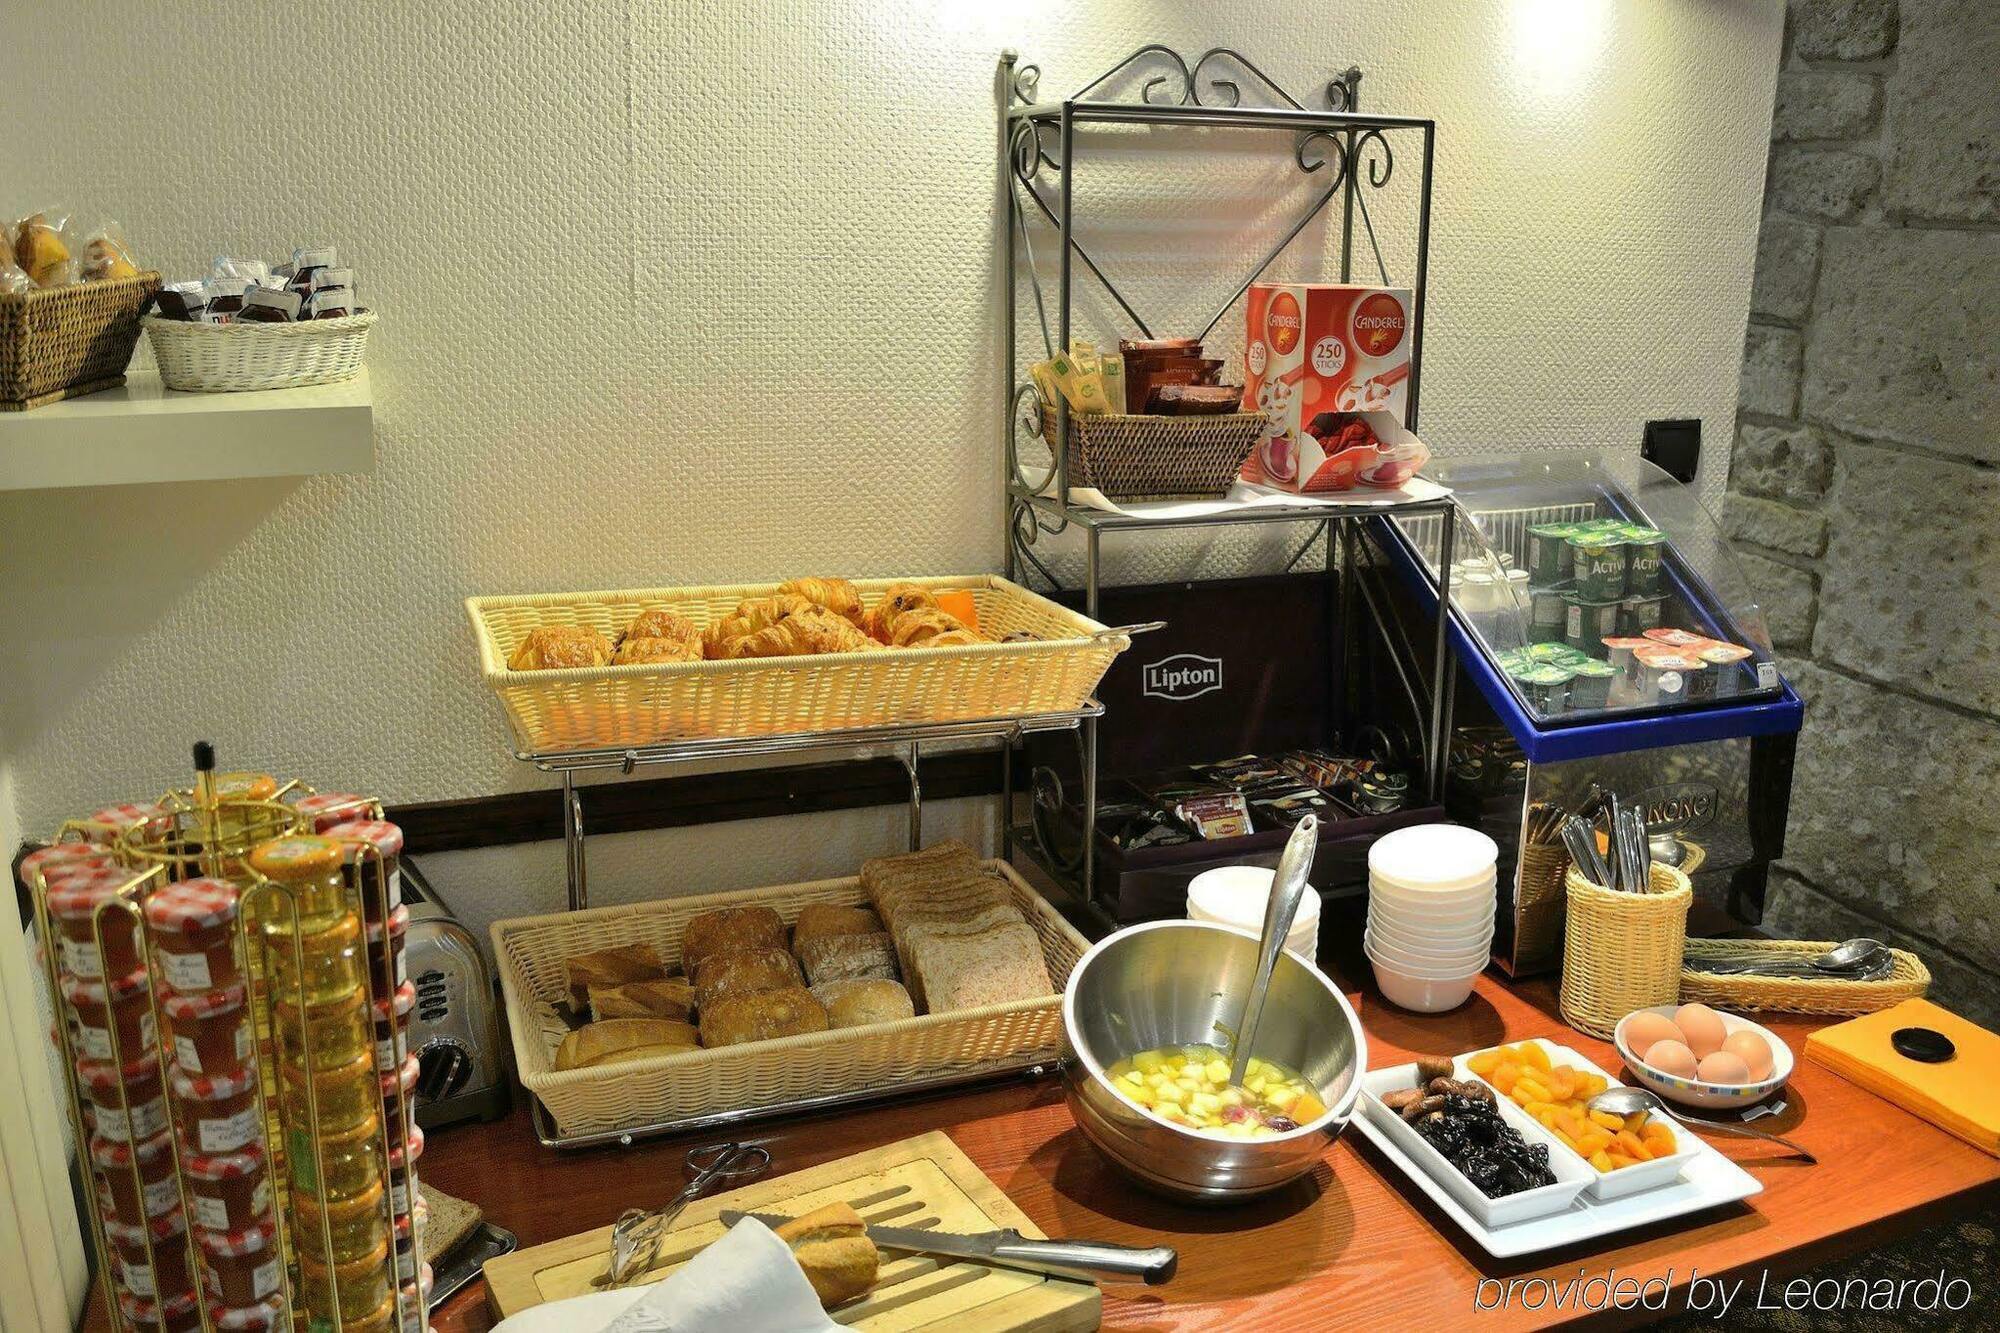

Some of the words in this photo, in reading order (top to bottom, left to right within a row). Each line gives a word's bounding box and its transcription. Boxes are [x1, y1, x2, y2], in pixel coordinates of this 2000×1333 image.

[1268, 313, 1300, 328] CANDEREL
[1355, 315, 1404, 329] CANDEREL
[1252, 346, 1264, 360] 250
[1316, 344, 1342, 359] 250
[1316, 360, 1342, 369] STICKS
[1150, 667, 1215, 692] Lipton
